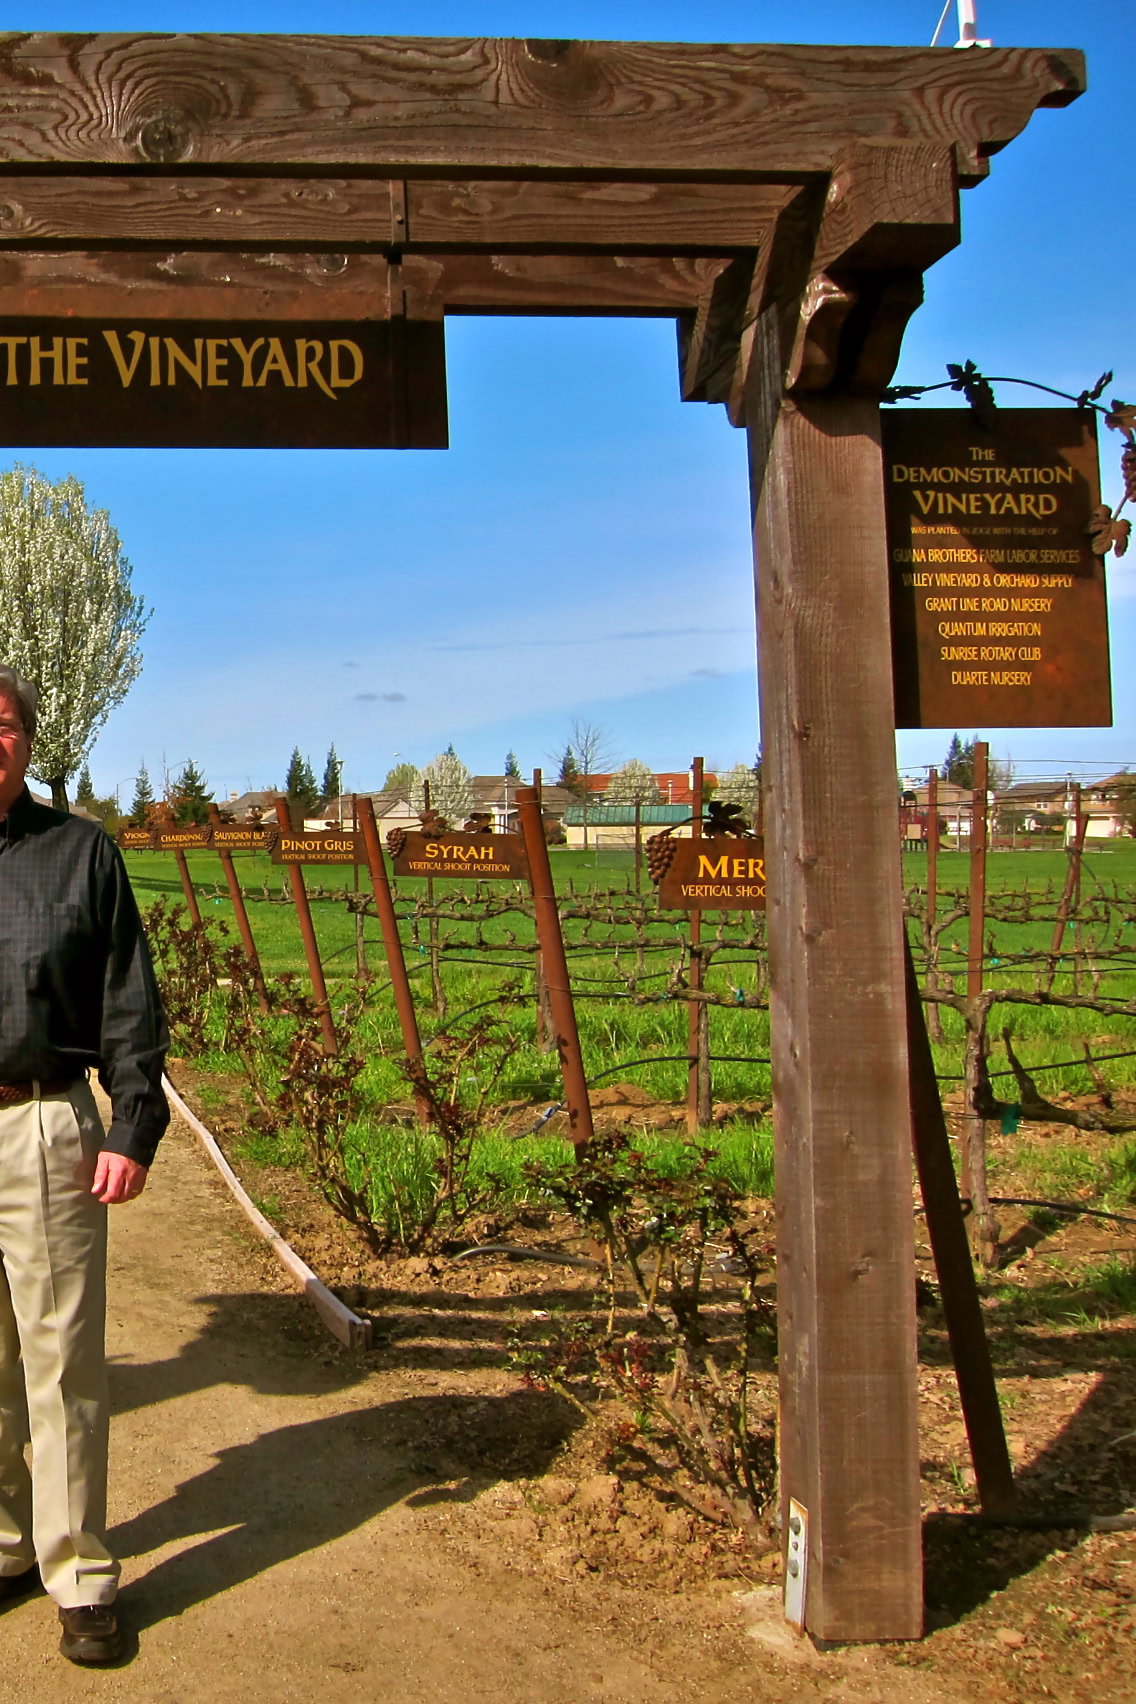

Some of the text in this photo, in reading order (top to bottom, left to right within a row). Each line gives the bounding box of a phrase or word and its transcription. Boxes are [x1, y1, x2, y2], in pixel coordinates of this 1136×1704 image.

[102, 330, 364, 400] VINEYARD
[969, 447, 996, 461] THE
[892, 464, 1072, 486] DEMONSTRATION
[912, 490, 1057, 519] VINEYARD
[911, 527, 926, 535] WAS
[927, 527, 960, 535] PLANTED
[928, 549, 978, 563] BROTHERS
[979, 549, 1004, 563] FARM
[1007, 549, 1039, 563] LABOR
[1039, 549, 1080, 563] SERVICES
[902, 573, 1073, 588] VALLEY VINEYARD & ORCHARD SUPPLY
[925, 598, 1052, 612] GRANT LINE ROAD NURSERY
[938, 622, 1041, 639] QUANTUM IRRIGATION
[941, 647, 1041, 661] SUNRISE ROTARY CLUB
[952, 671, 1032, 685] DUARTE NURSERY
[214, 831, 252, 840] SAUVIGNON
[281, 840, 354, 852] PINOT GRIS
[425, 843, 494, 861] SYRAH
[409, 861, 510, 873] VERTICAL SHOOT POSITION
[698, 855, 766, 880] MER
[681, 885, 732, 896] VERTICAL
